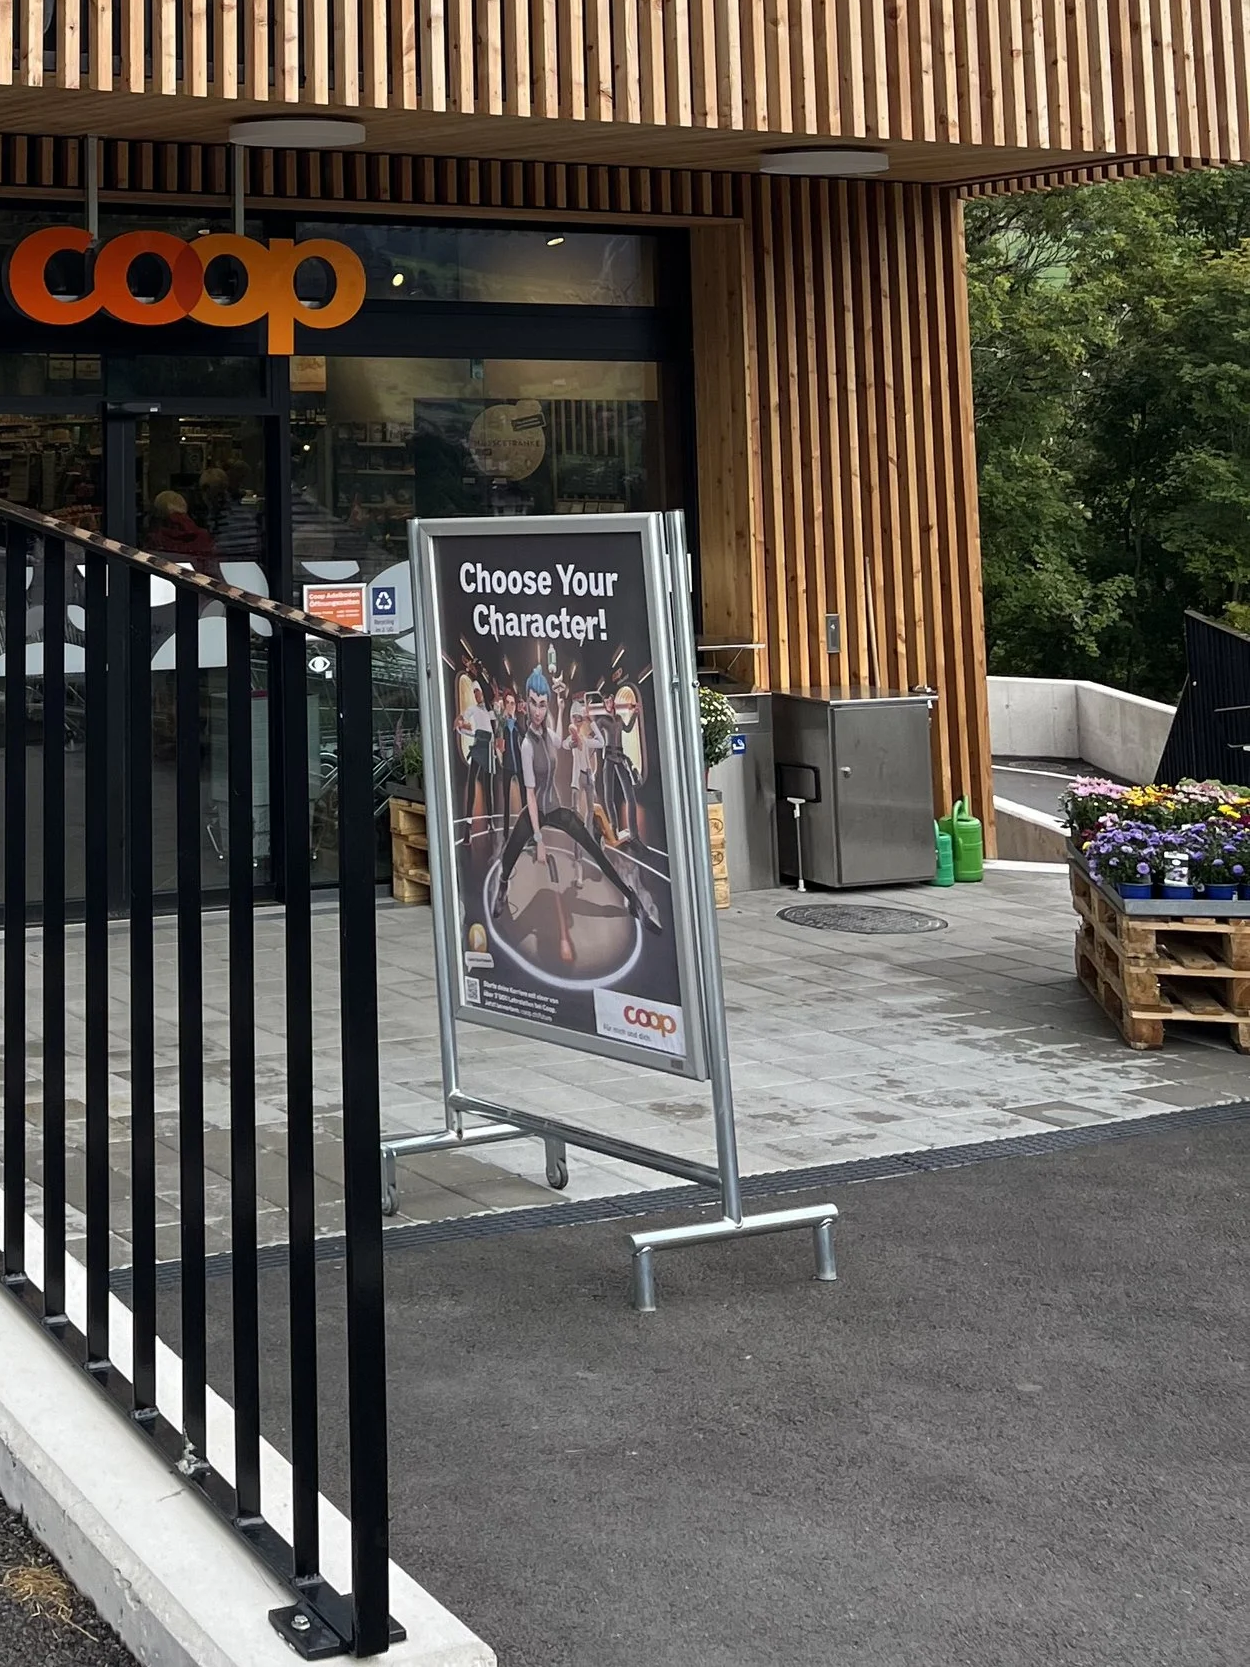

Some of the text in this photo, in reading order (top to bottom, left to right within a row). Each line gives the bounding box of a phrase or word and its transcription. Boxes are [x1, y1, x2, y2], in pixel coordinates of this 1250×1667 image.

[8, 226, 367, 355] coop
[459, 562, 618, 596] Choose Your
[473, 603, 608, 642] Character!
[623, 1005, 677, 1038] coop
